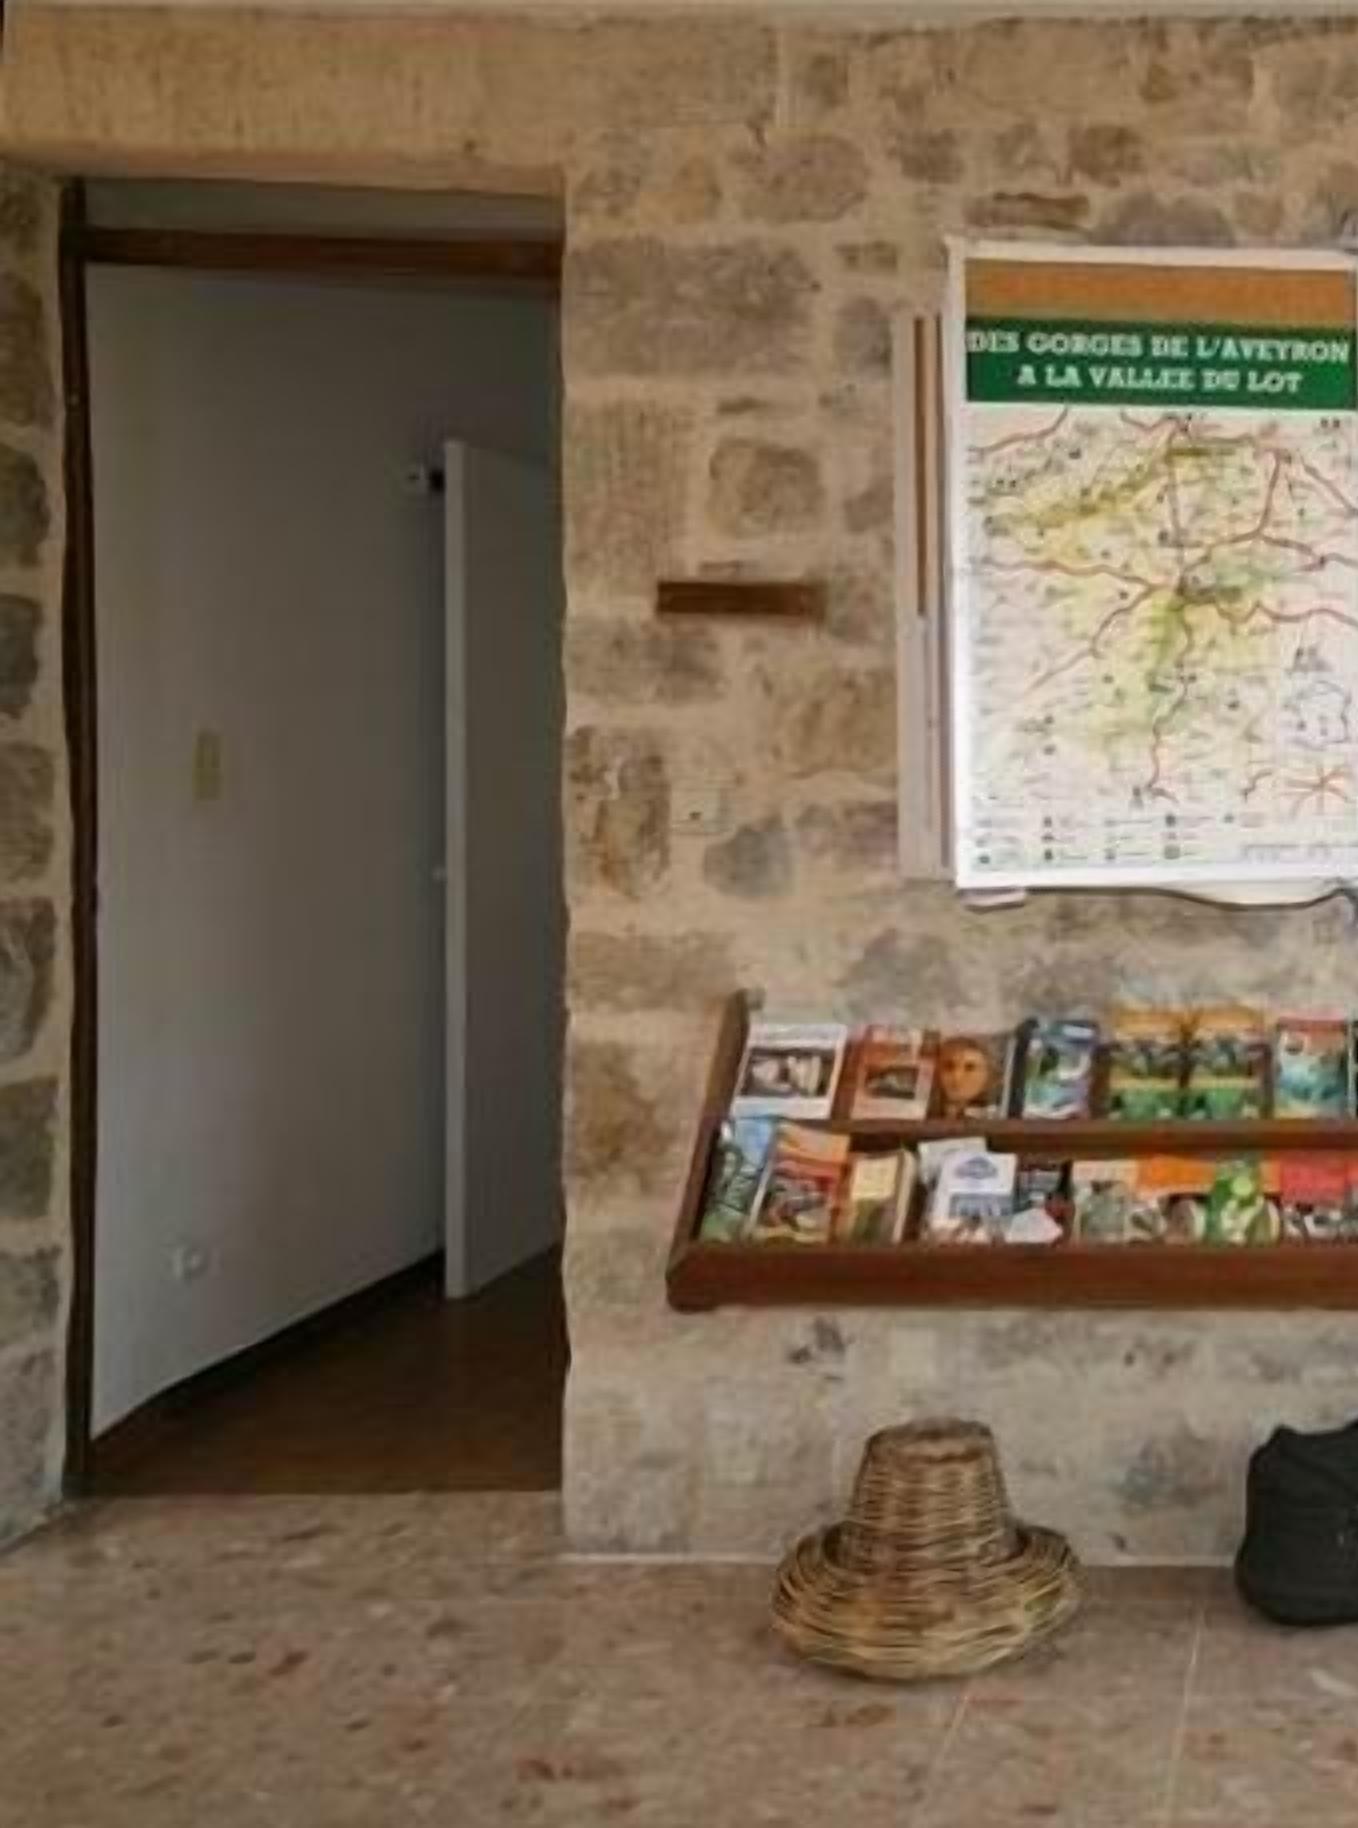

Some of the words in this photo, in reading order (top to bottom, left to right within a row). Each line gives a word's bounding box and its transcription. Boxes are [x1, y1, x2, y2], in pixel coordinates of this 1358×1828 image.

[967, 331, 1019, 354] DES
[1028, 332, 1143, 358] GORGES
[1152, 335, 1191, 359] DE
[1196, 336, 1350, 363] L'AVEYRON
[1017, 365, 1037, 386] A
[1046, 366, 1083, 388] LA
[1090, 367, 1195, 391] VALLEE
[1203, 370, 1239, 392] DU
[1247, 371, 1304, 394] LOT
